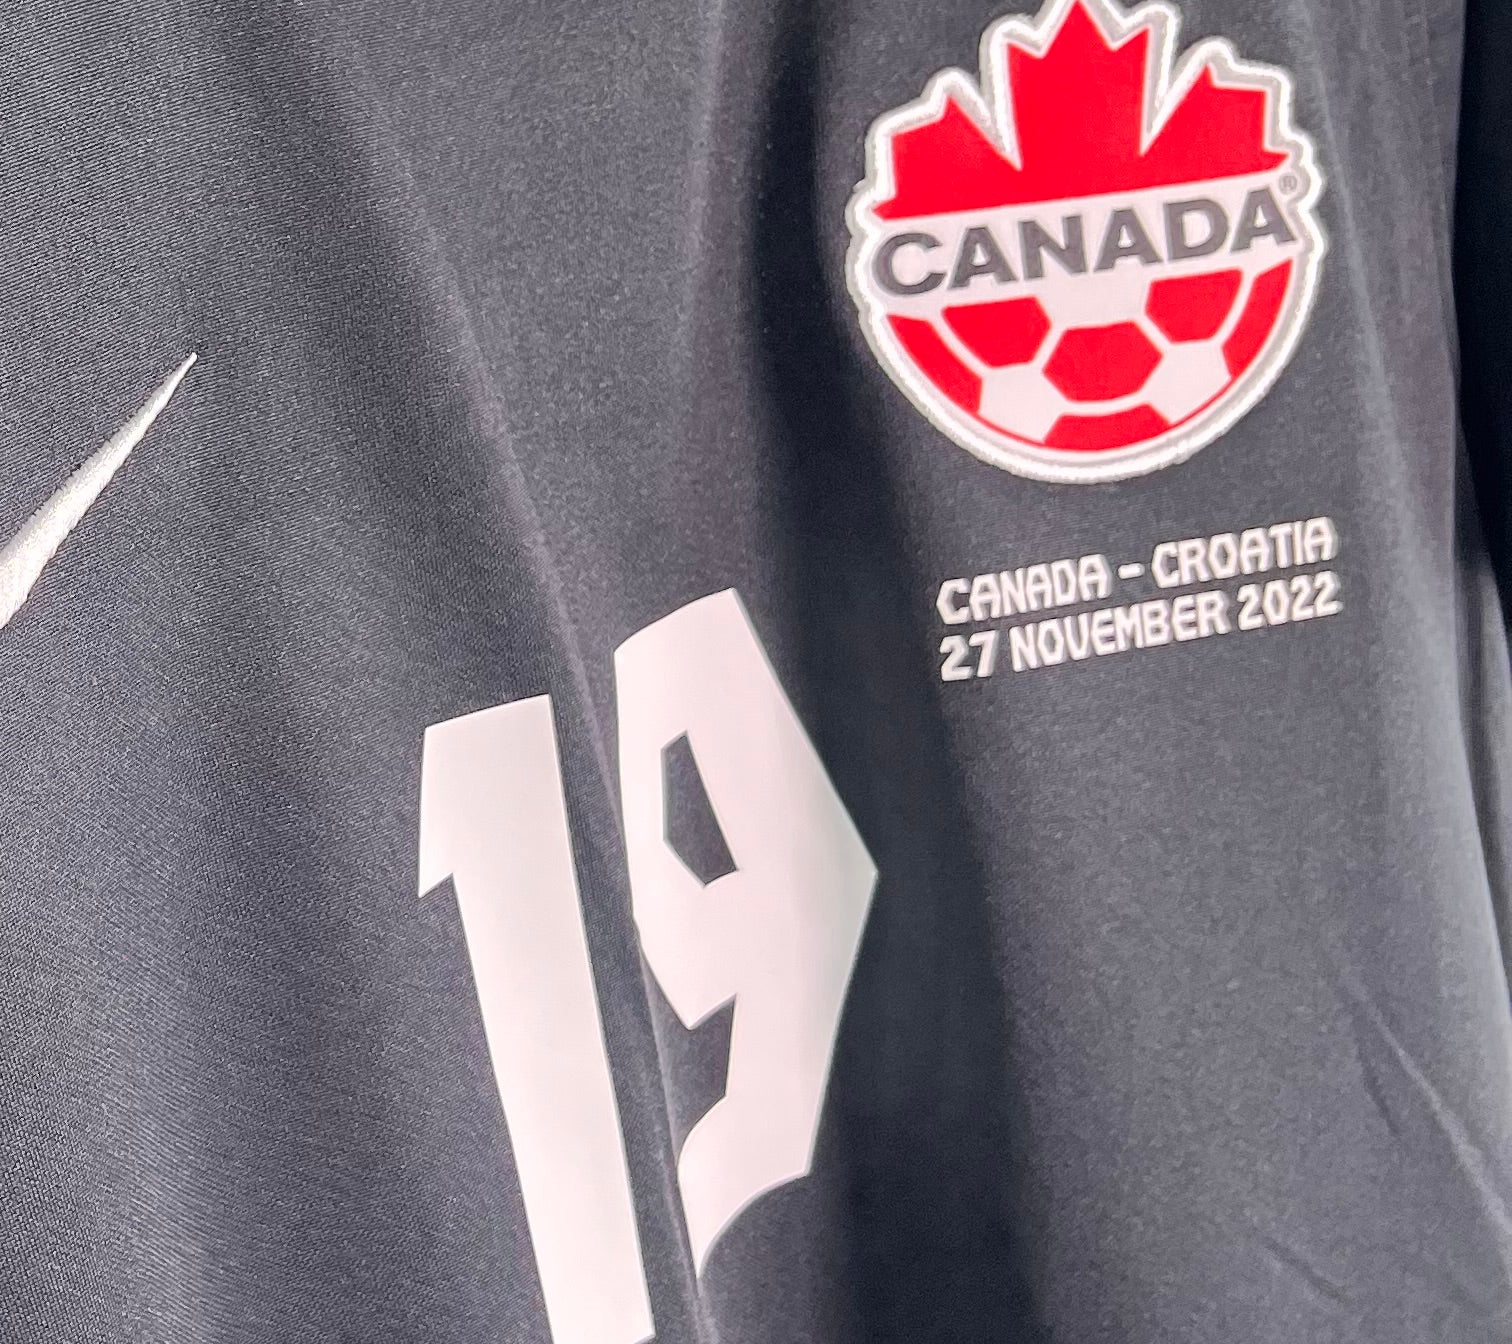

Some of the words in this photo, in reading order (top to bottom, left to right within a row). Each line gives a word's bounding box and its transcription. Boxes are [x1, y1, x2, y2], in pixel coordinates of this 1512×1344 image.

[872, 185, 1295, 296] CANADA
[936, 553, 1112, 625] CANADA
[1118, 563, 1145, 580] -
[1152, 516, 1339, 589] CROATIA
[939, 630, 999, 682] 27
[1008, 589, 1232, 673] NOVEMBER
[1237, 570, 1343, 631] 2022
